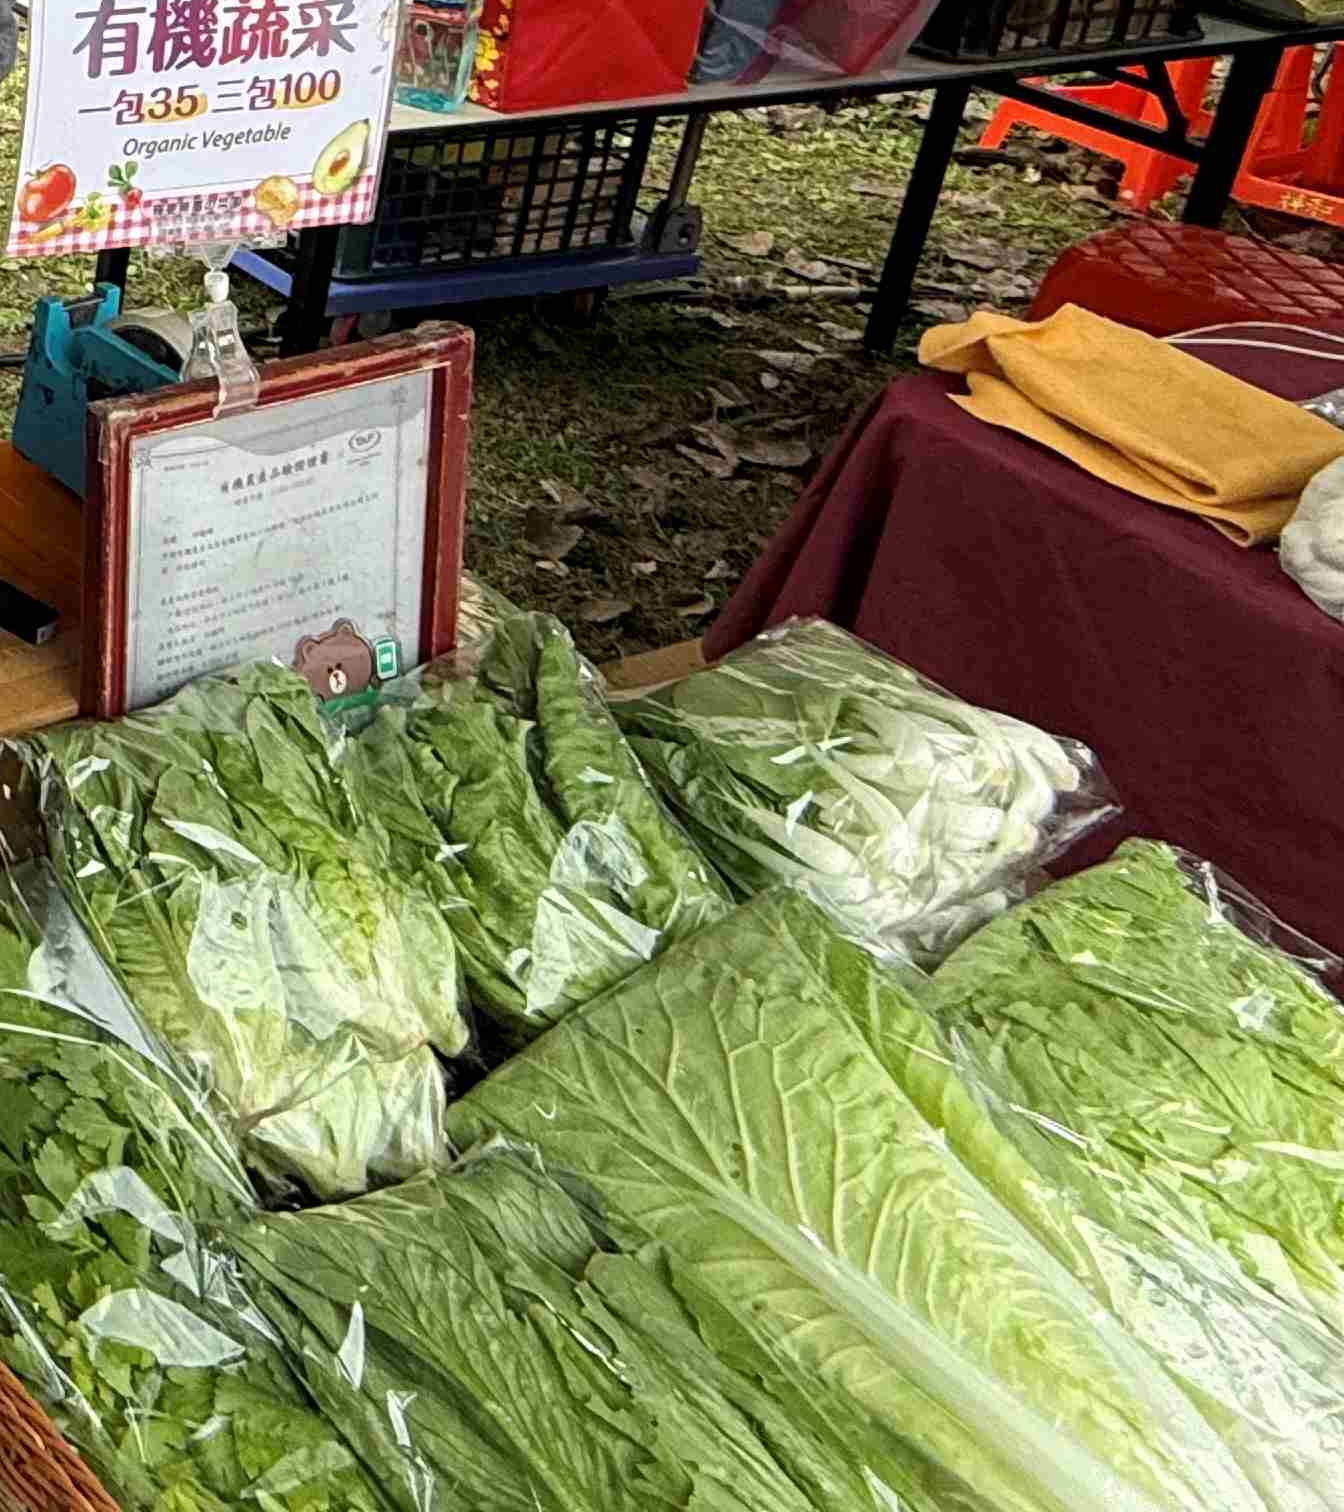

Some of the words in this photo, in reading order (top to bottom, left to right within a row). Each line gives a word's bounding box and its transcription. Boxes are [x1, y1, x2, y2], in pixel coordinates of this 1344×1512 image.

[78, 84, 200, 126] 一包35
[212, 68, 342, 114] 三包100
[123, 127, 197, 160] Organic
[201, 120, 291, 154] Vegetable
